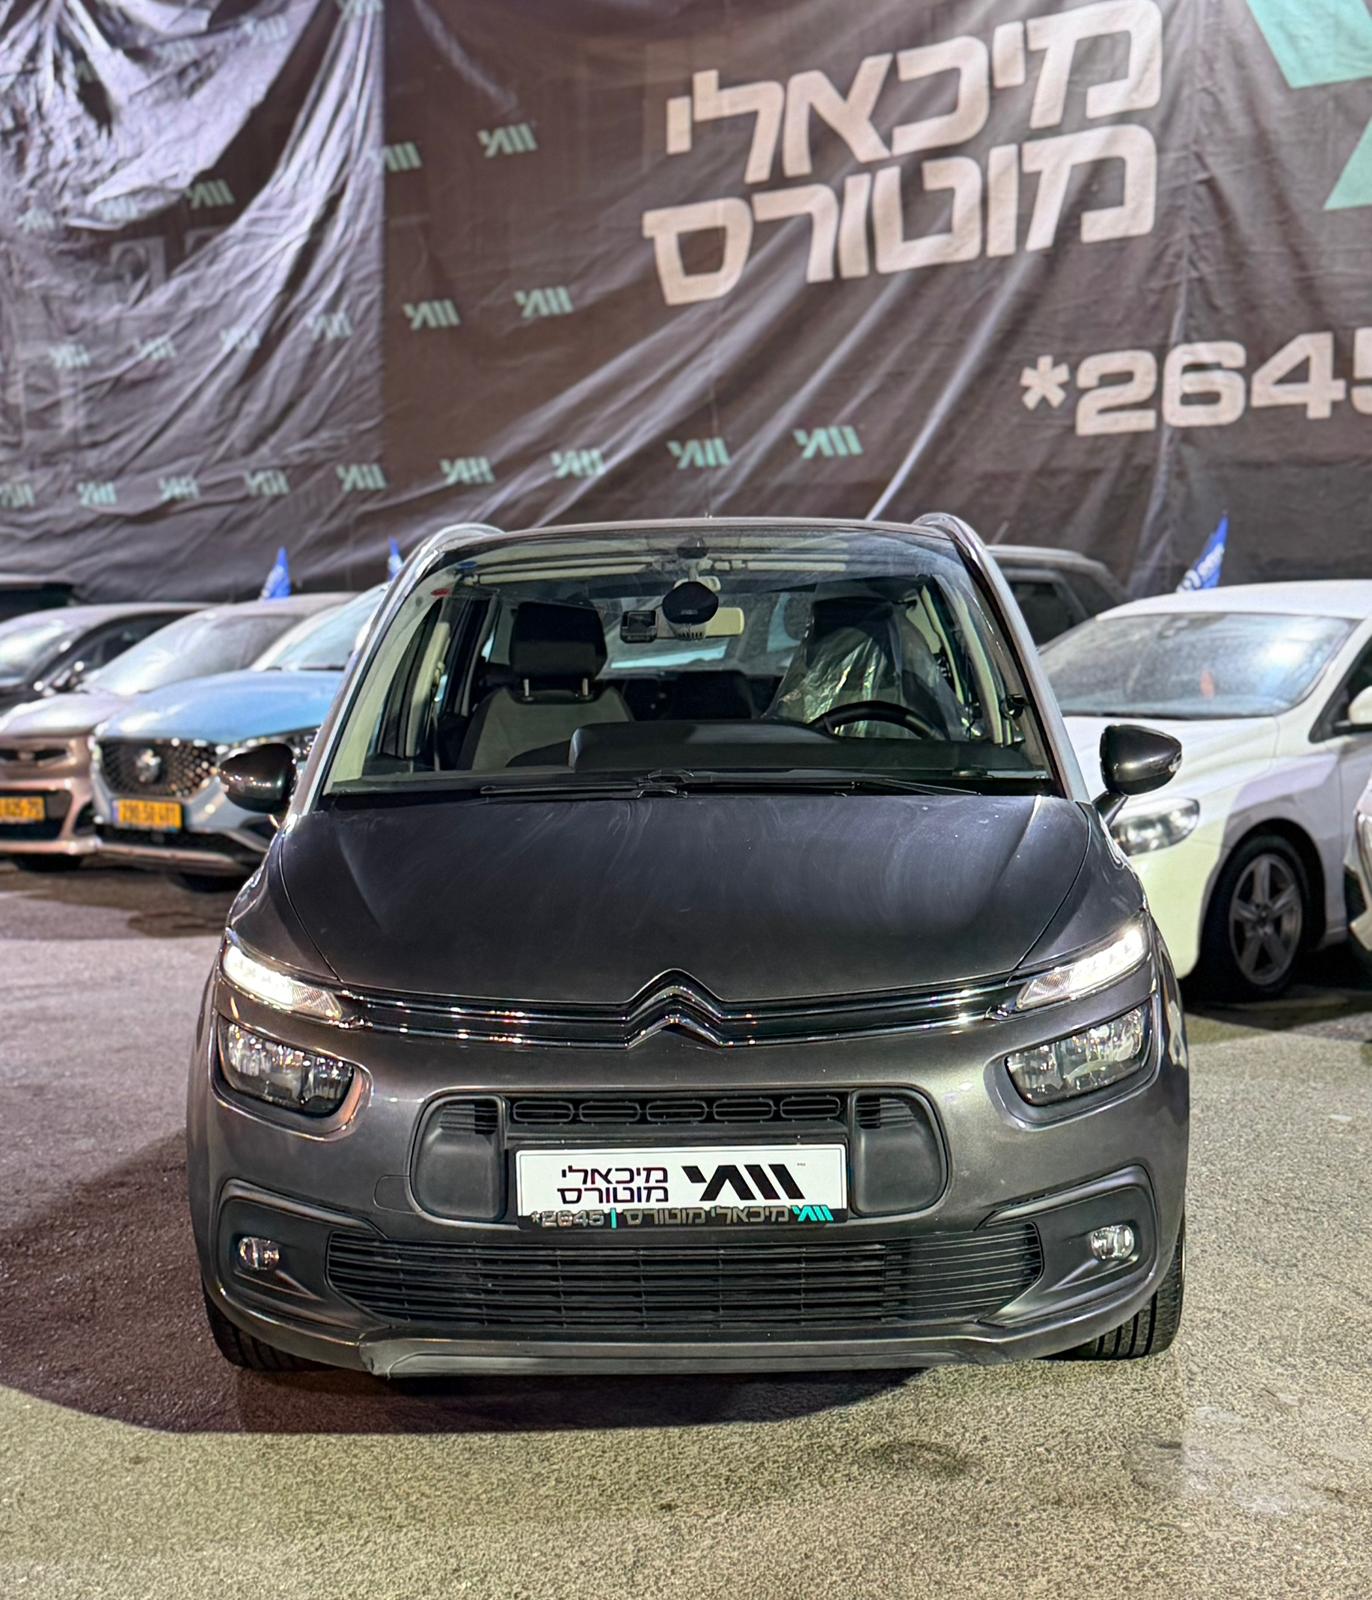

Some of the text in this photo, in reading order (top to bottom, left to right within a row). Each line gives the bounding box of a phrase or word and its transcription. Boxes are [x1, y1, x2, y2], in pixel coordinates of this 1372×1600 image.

[666, 0, 1162, 183] מיכאלי
[643, 123, 1157, 305] מוטורס
[1020, 327, 1372, 436] 264
[561, 1165, 669, 1186] מיכאלי
[557, 1186, 669, 1205] מוטורס
[623, 1208, 706, 1226] מוטורס
[710, 1206, 790, 1225] מיכאלי
